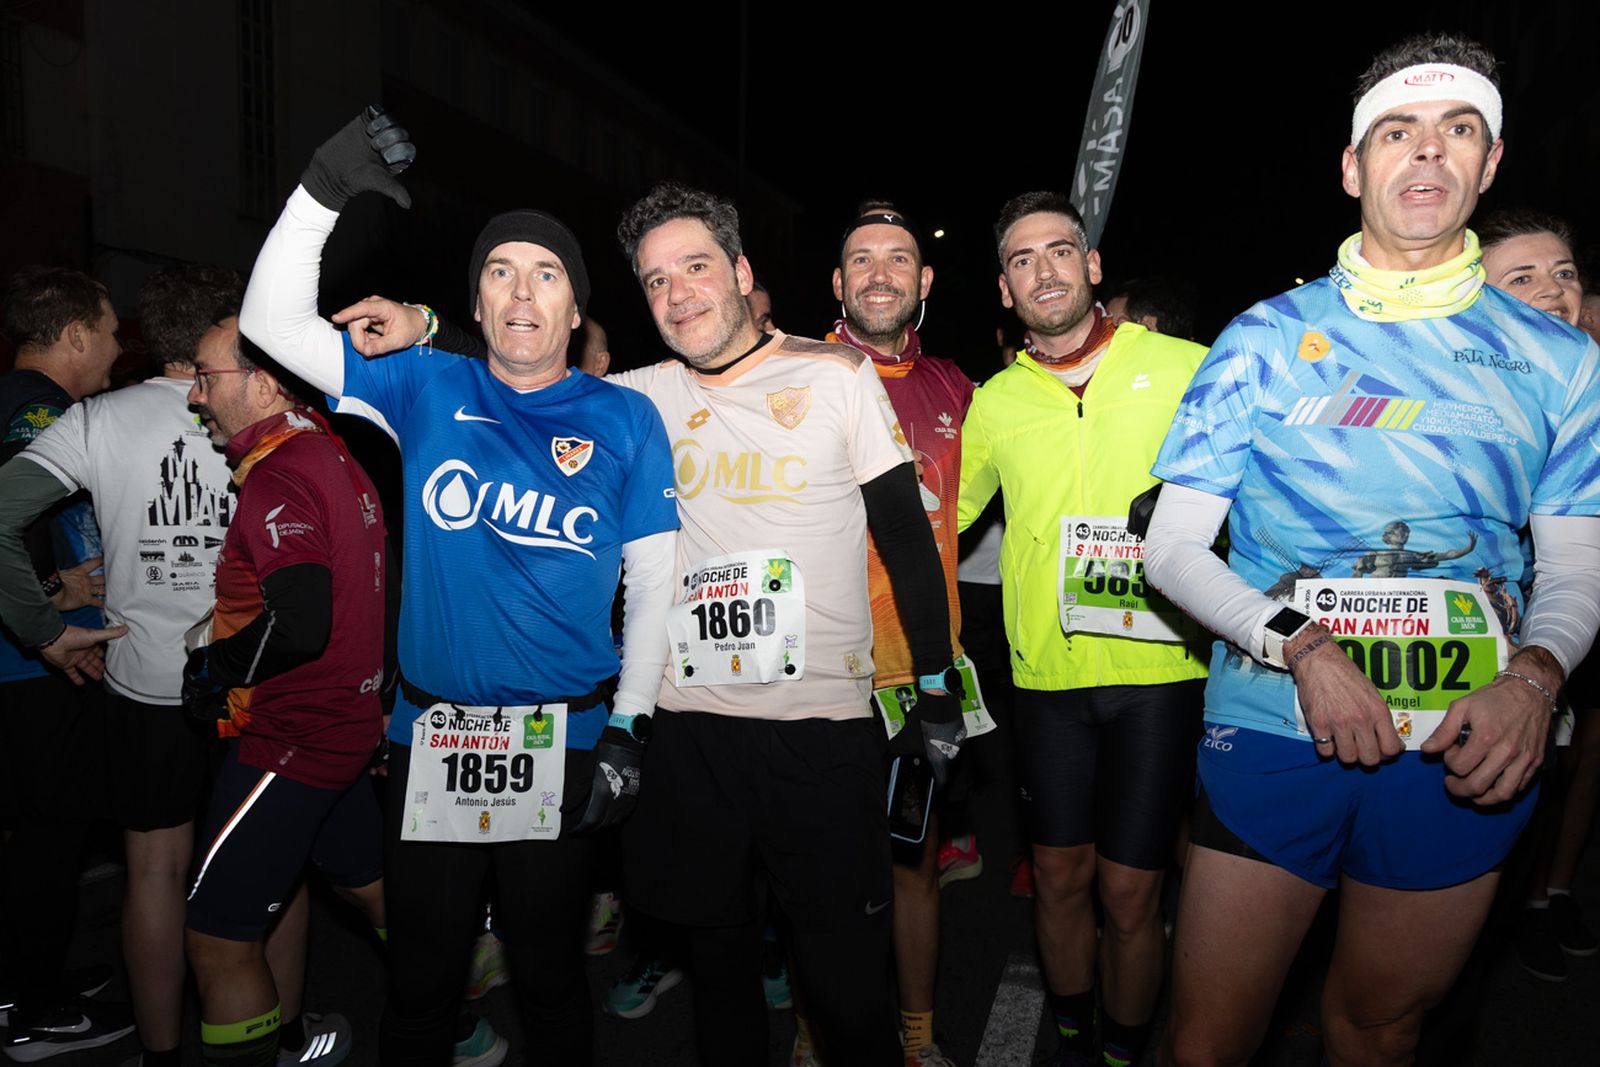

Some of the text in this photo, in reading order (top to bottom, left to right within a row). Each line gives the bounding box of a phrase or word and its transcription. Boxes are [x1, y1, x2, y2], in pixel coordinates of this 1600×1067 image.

[1453, 348, 1485, 366] PATA
[714, 451, 807, 492] MLC
[492, 483, 598, 544] MLC
[1076, 526, 1089, 535] 43
[733, 567, 748, 580] DE
[706, 580, 748, 599] ANTÓN
[1120, 599, 1138, 608] Raúl
[1316, 594, 1336, 606] 43
[1340, 597, 1428, 613] NOCHE DE
[691, 597, 776, 641] 1860
[1319, 614, 1429, 636] SAN ANTÓN
[715, 642, 755, 651] Pedro Juan
[431, 714, 446, 724] 43
[449, 718, 511, 732] NOCHE DE
[430, 732, 510, 750] SAN ANTÓN
[1204, 738, 1233, 752] ZICO
[442, 753, 534, 794] 1859
[455, 796, 516, 807] Antonio Jesús
